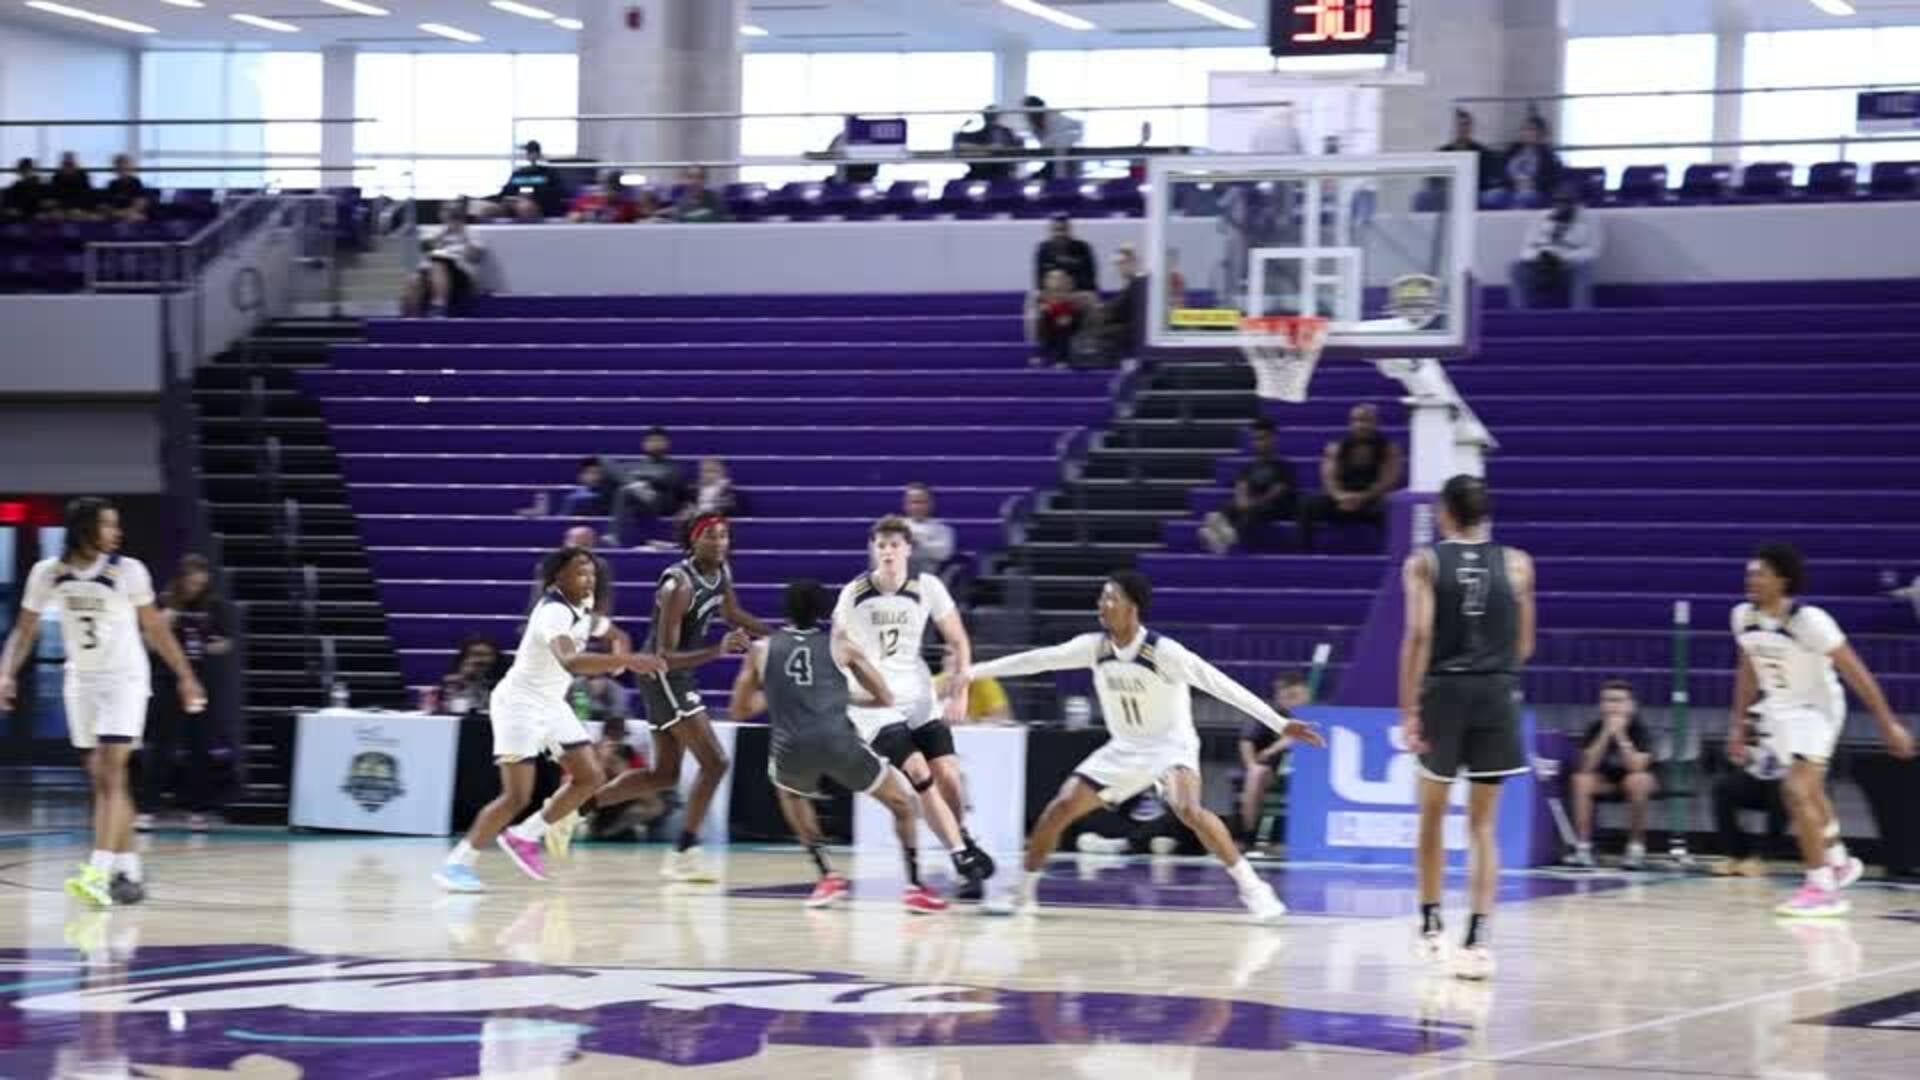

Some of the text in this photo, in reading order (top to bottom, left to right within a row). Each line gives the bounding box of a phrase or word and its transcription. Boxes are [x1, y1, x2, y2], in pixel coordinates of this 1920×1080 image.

[1292, 0, 1373, 41] 30
[78, 615, 99, 651] 3
[879, 627, 900, 658] 12
[784, 646, 813, 686] 4
[1120, 696, 1144, 727] 11
